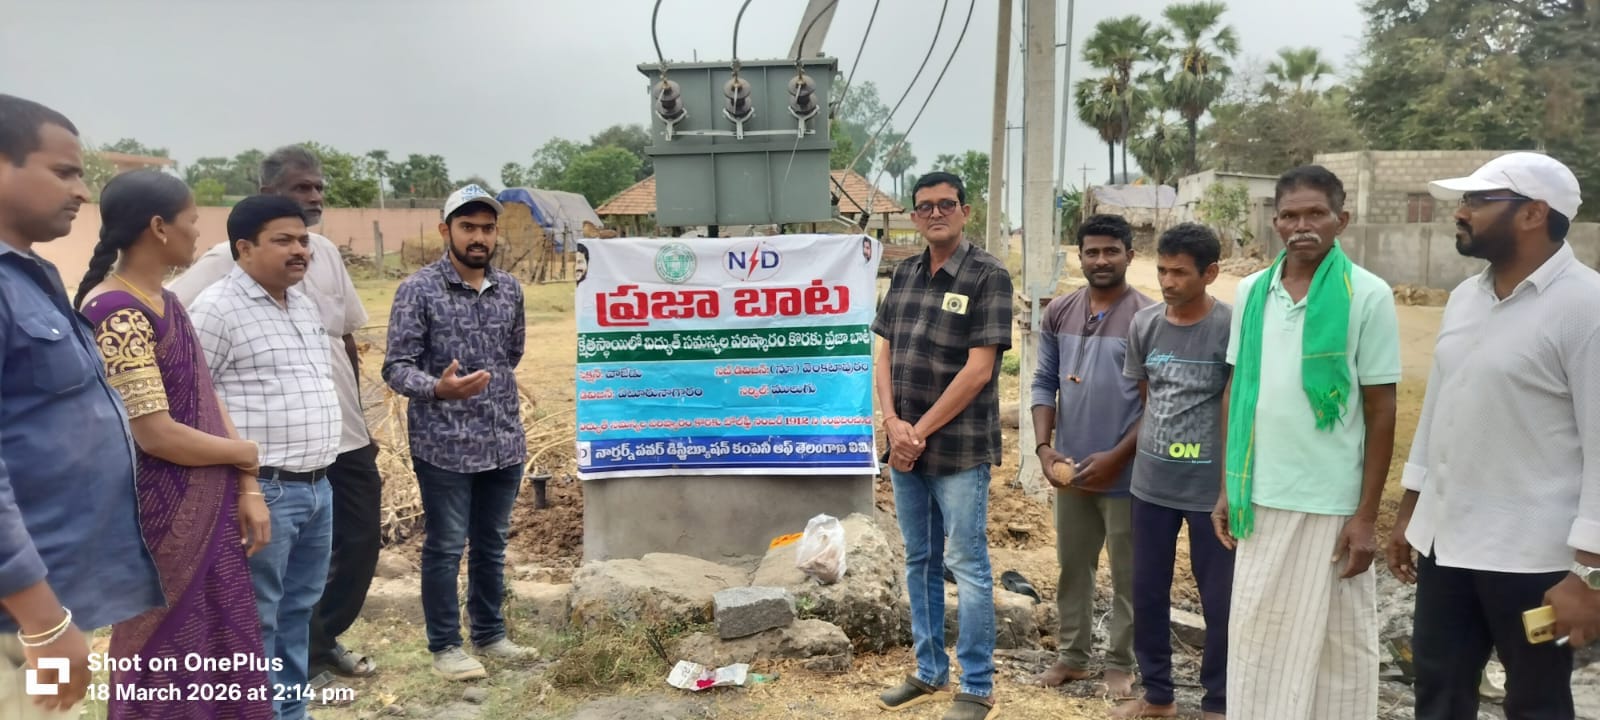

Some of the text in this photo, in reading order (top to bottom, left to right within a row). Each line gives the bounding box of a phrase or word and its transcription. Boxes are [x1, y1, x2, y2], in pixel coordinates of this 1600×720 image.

[596, 279, 850, 327] ప్రజా బాట
[644, 334, 681, 356] విద్యుత్
[683, 334, 729, 354] సమస్యల
[731, 332, 786, 351] పరిష్కారం
[788, 331, 822, 346] కొరకు
[825, 330, 848, 350] ప్రజా
[785, 417, 809, 425] 1912
[635, 441, 665, 458] పవర్
[732, 442, 771, 456] కంపెనీ
[773, 440, 794, 456] ఆఫ్
[795, 441, 847, 455] తెలంగాణ
[1169, 442, 1201, 458] ON
